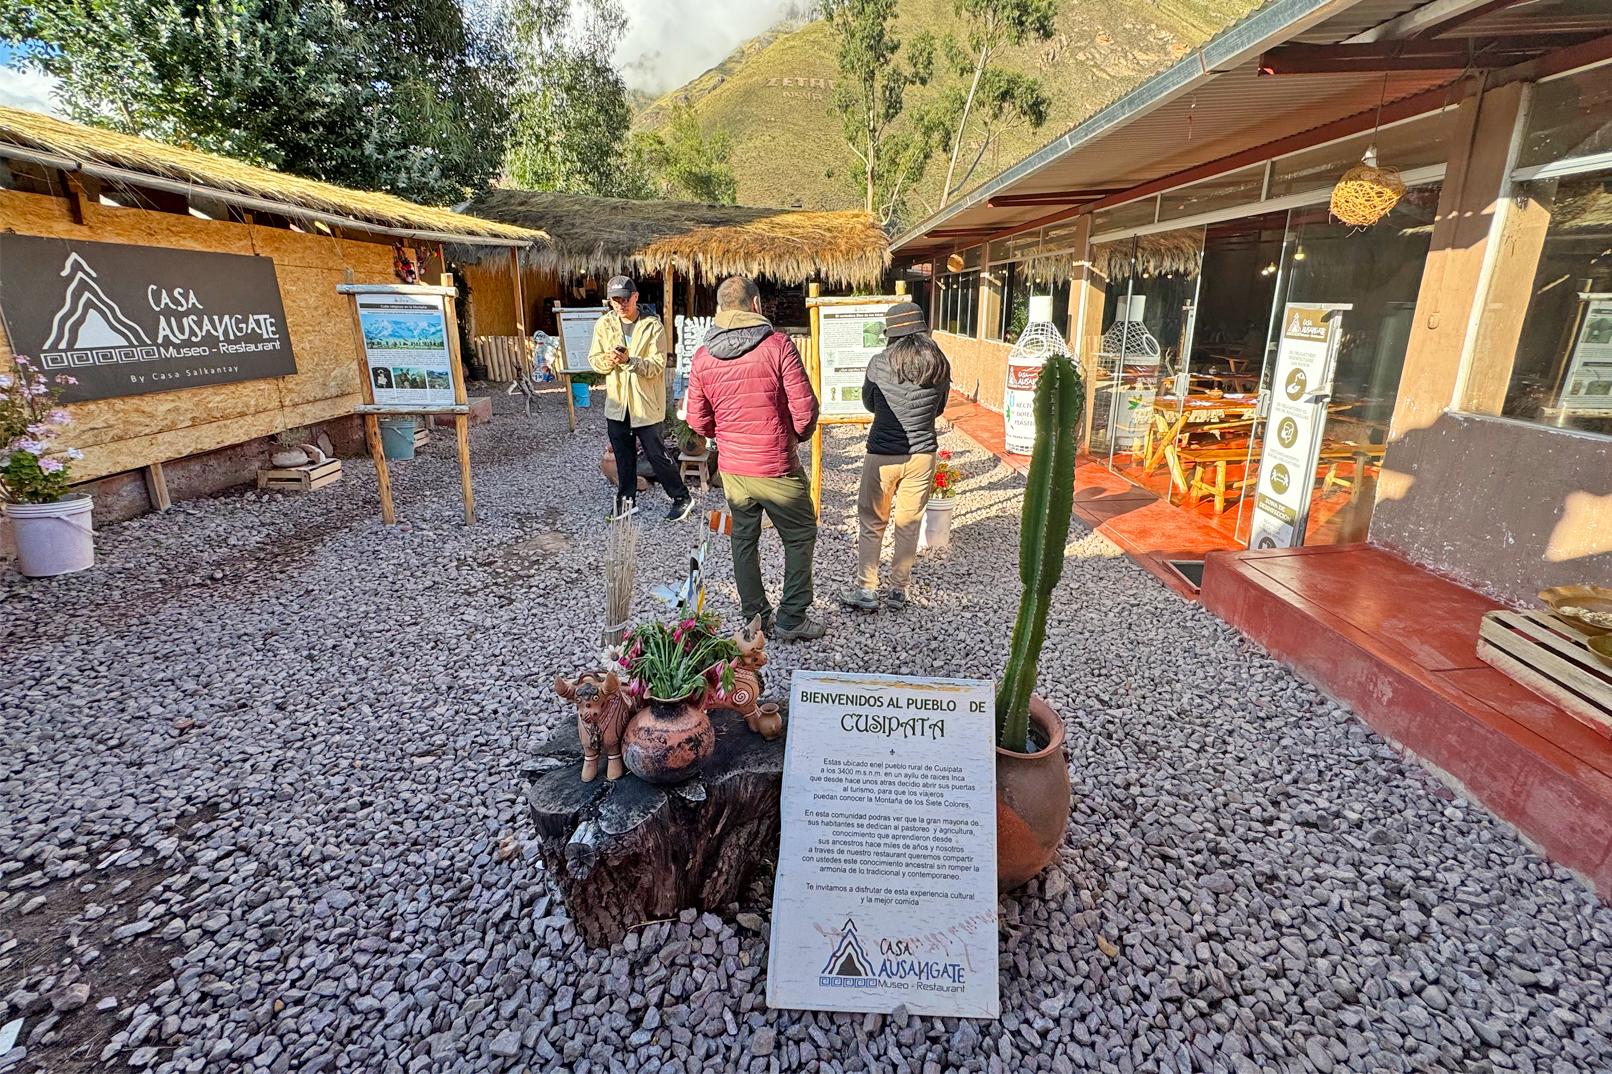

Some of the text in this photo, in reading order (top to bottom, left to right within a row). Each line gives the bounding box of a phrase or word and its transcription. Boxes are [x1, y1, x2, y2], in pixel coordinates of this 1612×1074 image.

[148, 284, 204, 312] CASA
[156, 313, 280, 344] AUSANGATE
[160, 346, 210, 358] Museo
[219, 340, 280, 354] Restaurant
[130, 365, 239, 384] By Casa Salkantay
[800, 690, 986, 712] BIENVENIDOS AL PUEBLO DE
[840, 713, 945, 740] CUSIPATA
[824, 758, 842, 766] Estas
[884, 762, 906, 770] pueblo
[934, 765, 962, 774] Cusipata
[904, 772, 918, 780] ayllu
[840, 794, 865, 802] conocer
[874, 796, 902, 804] Montaña
[850, 786, 876, 794] turismo,
[878, 788, 892, 796] para
[919, 790, 944, 798] viajeros
[831, 811, 866, 820] comunidad
[868, 814, 891, 822] podras
[821, 820, 854, 828] habitantes
[901, 824, 930, 832] pastoreo
[832, 830, 876, 838] conocimiento
[891, 833, 930, 842] aprendieron
[832, 839, 864, 847] ancestros
[865, 840, 882, 848] hace
[912, 843, 928, 851] años
[873, 850, 906, 858] restaurant
[908, 853, 941, 861] queremos
[816, 856, 842, 864] ustedes
[860, 859, 904, 867] conocimiento
[904, 862, 935, 870] ancestral
[948, 864, 972, 872] romper
[974, 864, 980, 872] la
[866, 867, 900, 876] tradicional
[806, 882, 814, 890] Te
[816, 884, 848, 892] invitamos
[855, 886, 882, 894] disfrutar
[910, 890, 948, 898] experiencia
[950, 892, 975, 900] cultural
[874, 898, 894, 906] mejor
[894, 898, 920, 906] comida
[880, 938, 912, 956] CASA
[878, 958, 966, 984] AUSANGATE
[878, 980, 908, 989] Museo
[916, 982, 966, 992] Restaurant
